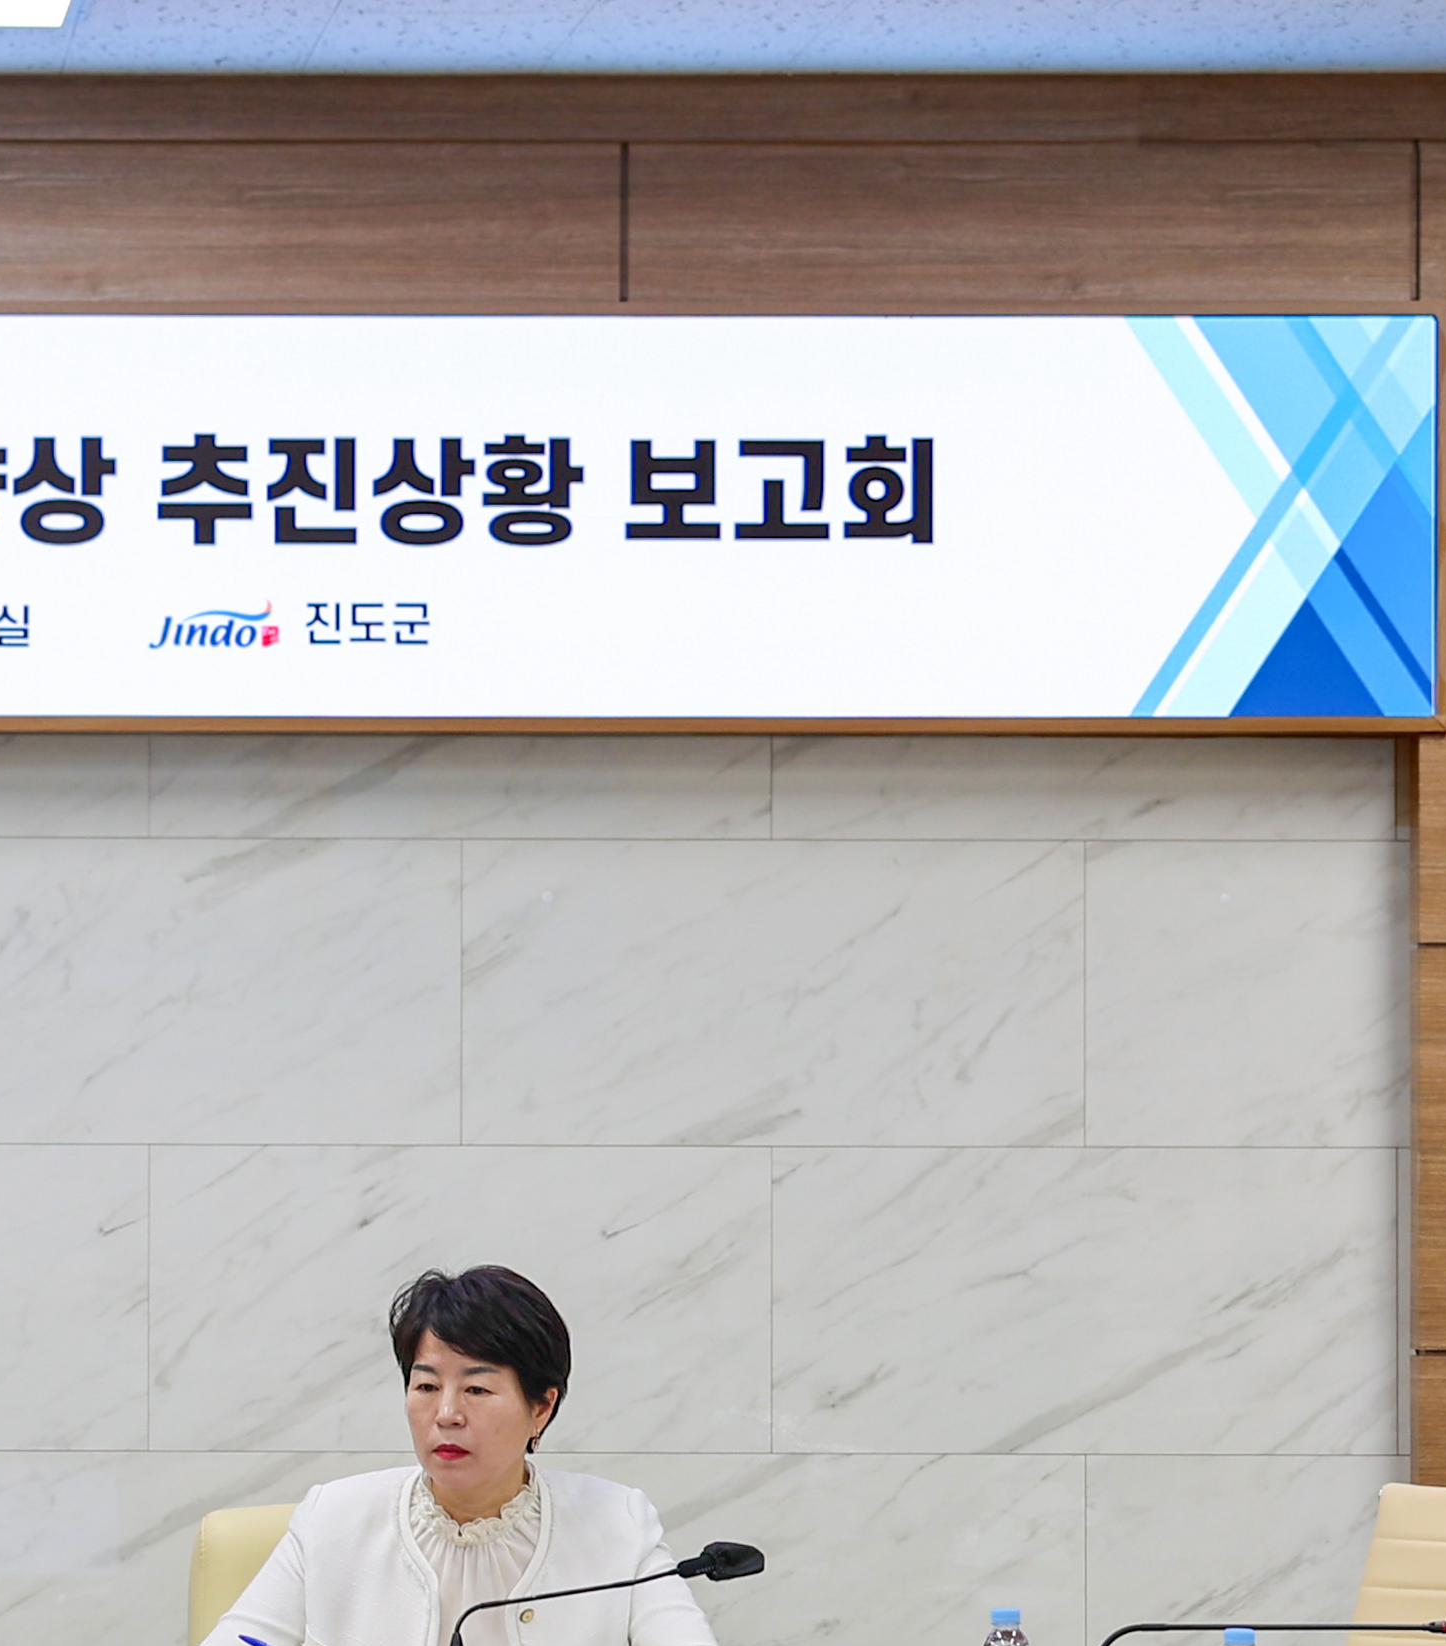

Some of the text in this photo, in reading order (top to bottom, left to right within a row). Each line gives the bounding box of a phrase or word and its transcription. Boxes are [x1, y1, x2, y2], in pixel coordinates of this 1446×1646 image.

[157, 433, 586, 548] 추진상황
[624, 434, 935, 546] 보고회
[149, 613, 260, 649] Jindo
[305, 601, 431, 646] 진도군
